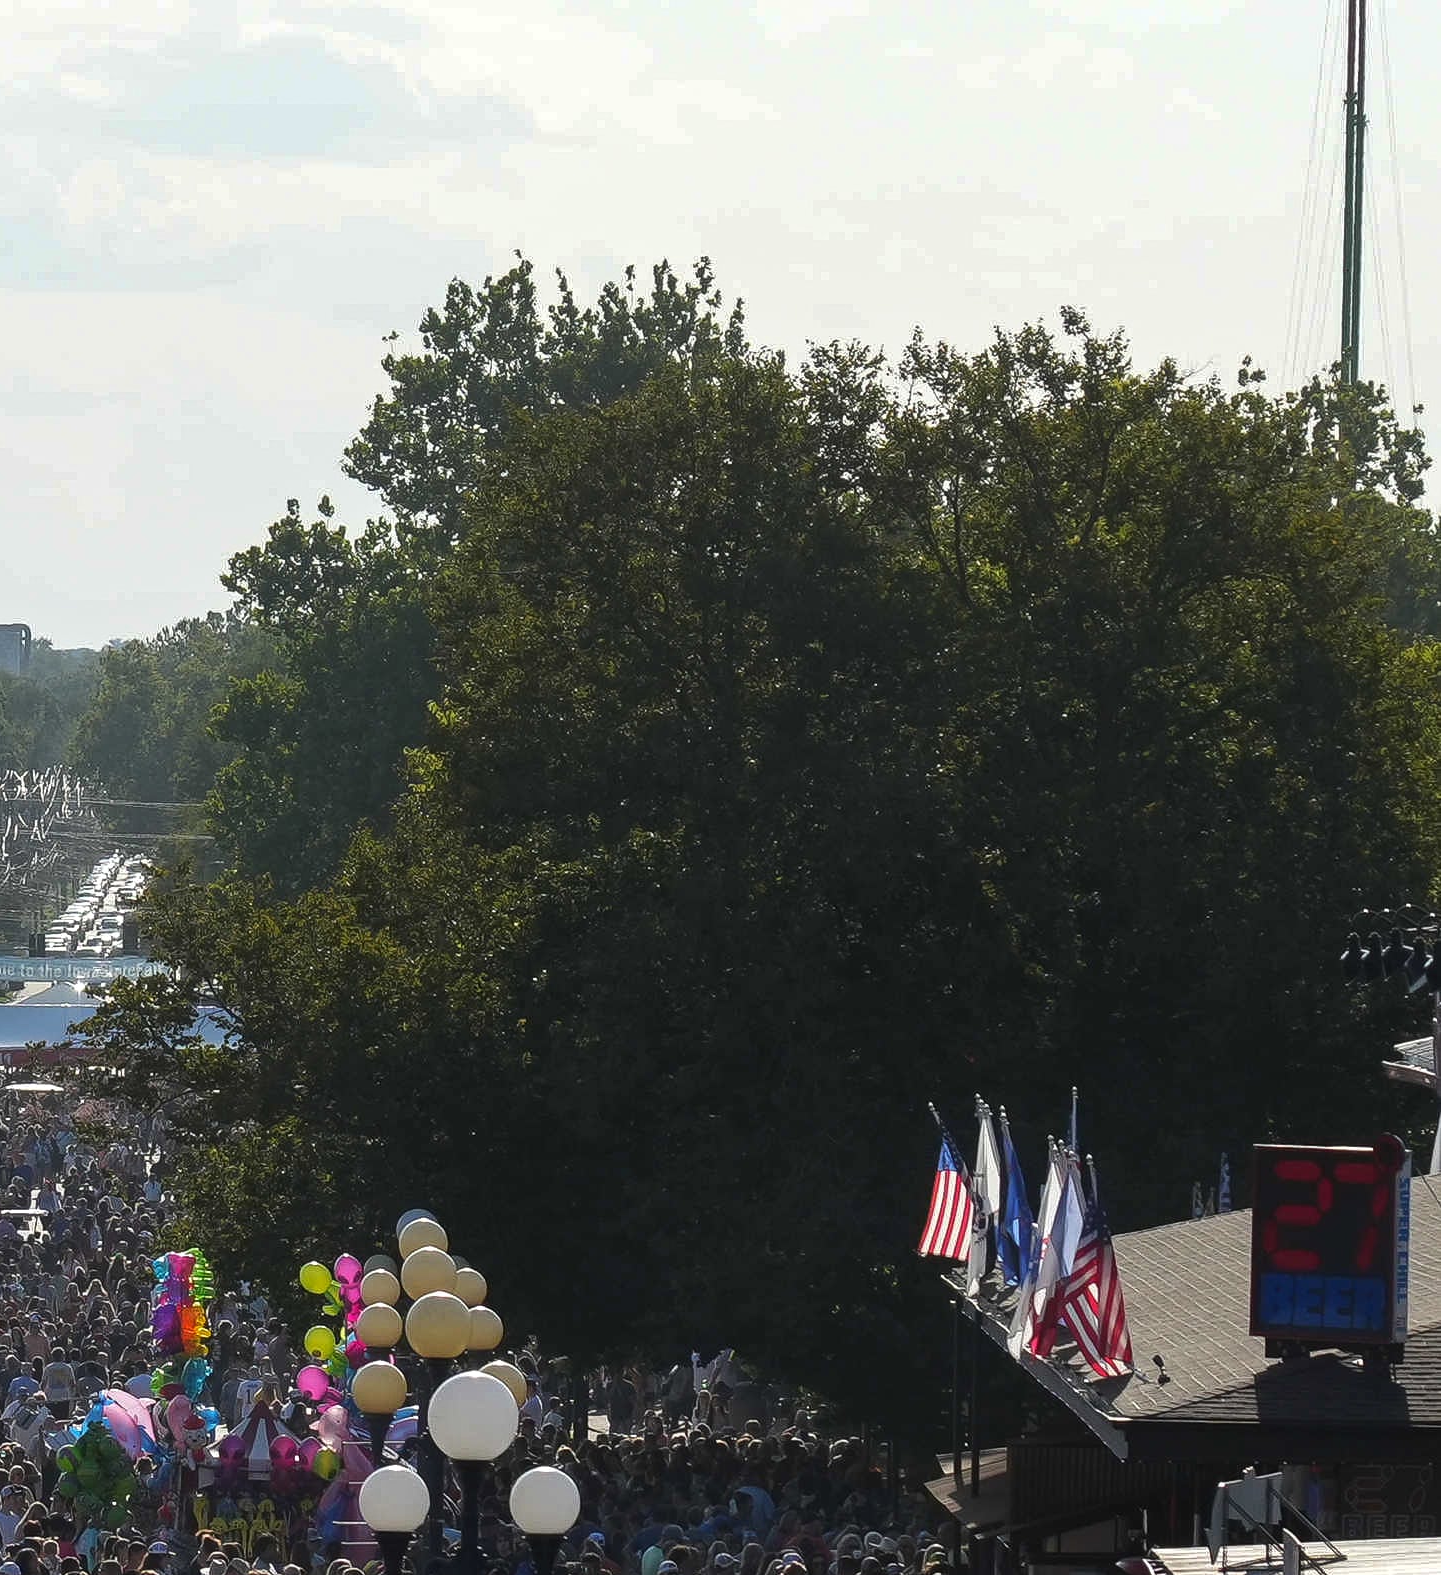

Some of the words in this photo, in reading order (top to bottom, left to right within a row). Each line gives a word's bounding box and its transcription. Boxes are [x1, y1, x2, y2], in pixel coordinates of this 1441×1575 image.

[20, 963, 34, 977] to
[38, 962, 61, 978] the
[1260, 1273, 1387, 1330] BEER
